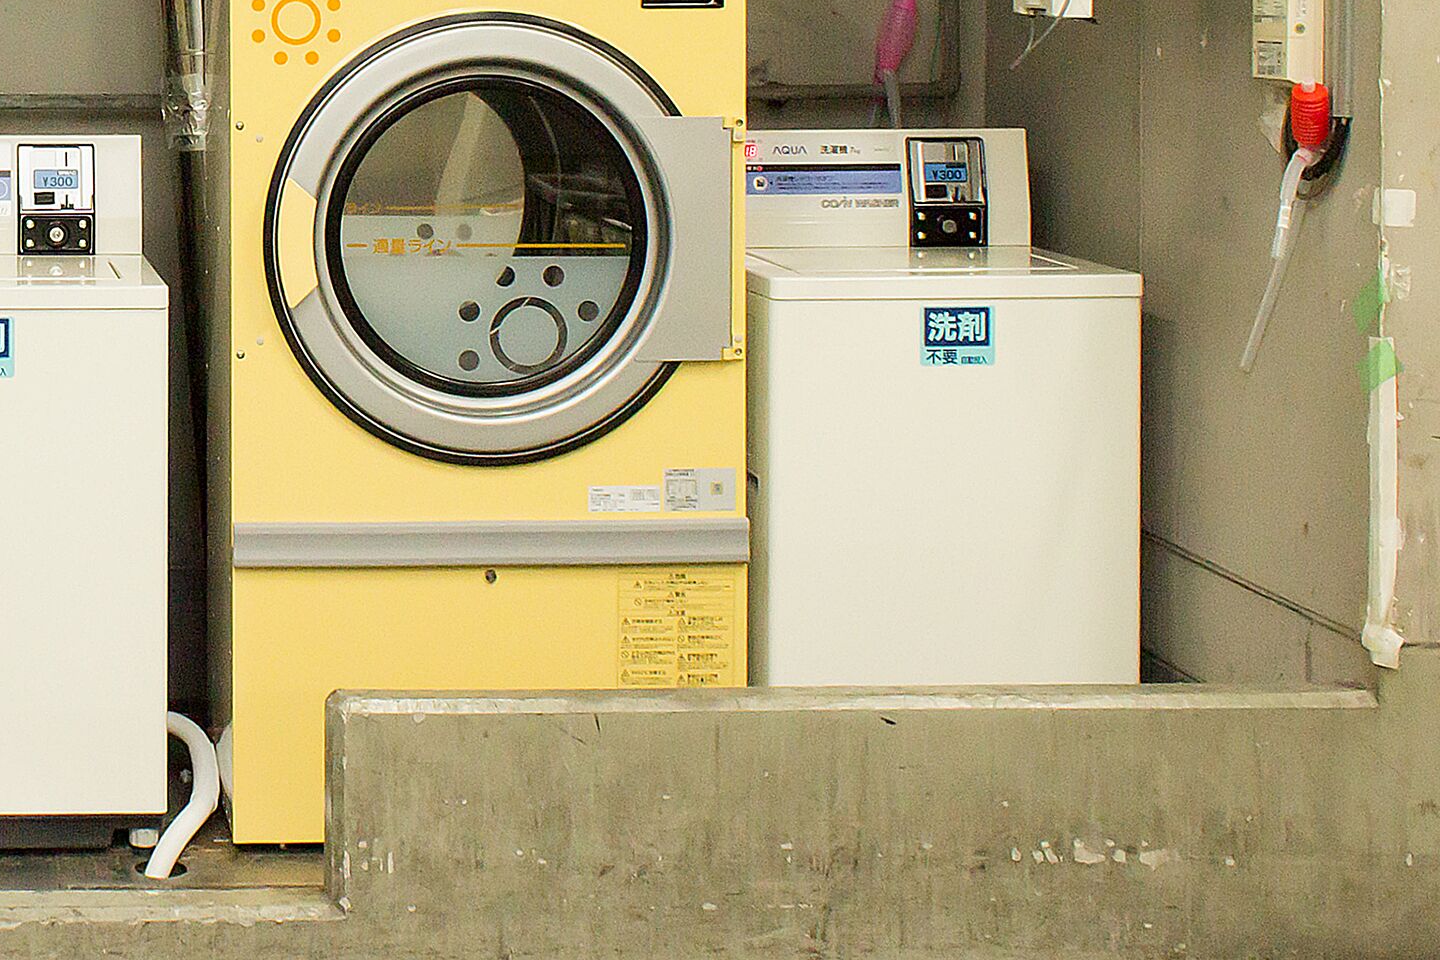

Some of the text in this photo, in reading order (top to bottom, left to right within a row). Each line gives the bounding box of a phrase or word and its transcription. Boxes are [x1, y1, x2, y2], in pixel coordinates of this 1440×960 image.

[772, 146, 808, 155] AQUA
[928, 312, 987, 342] 洗剤
[926, 349, 958, 364] 不要
